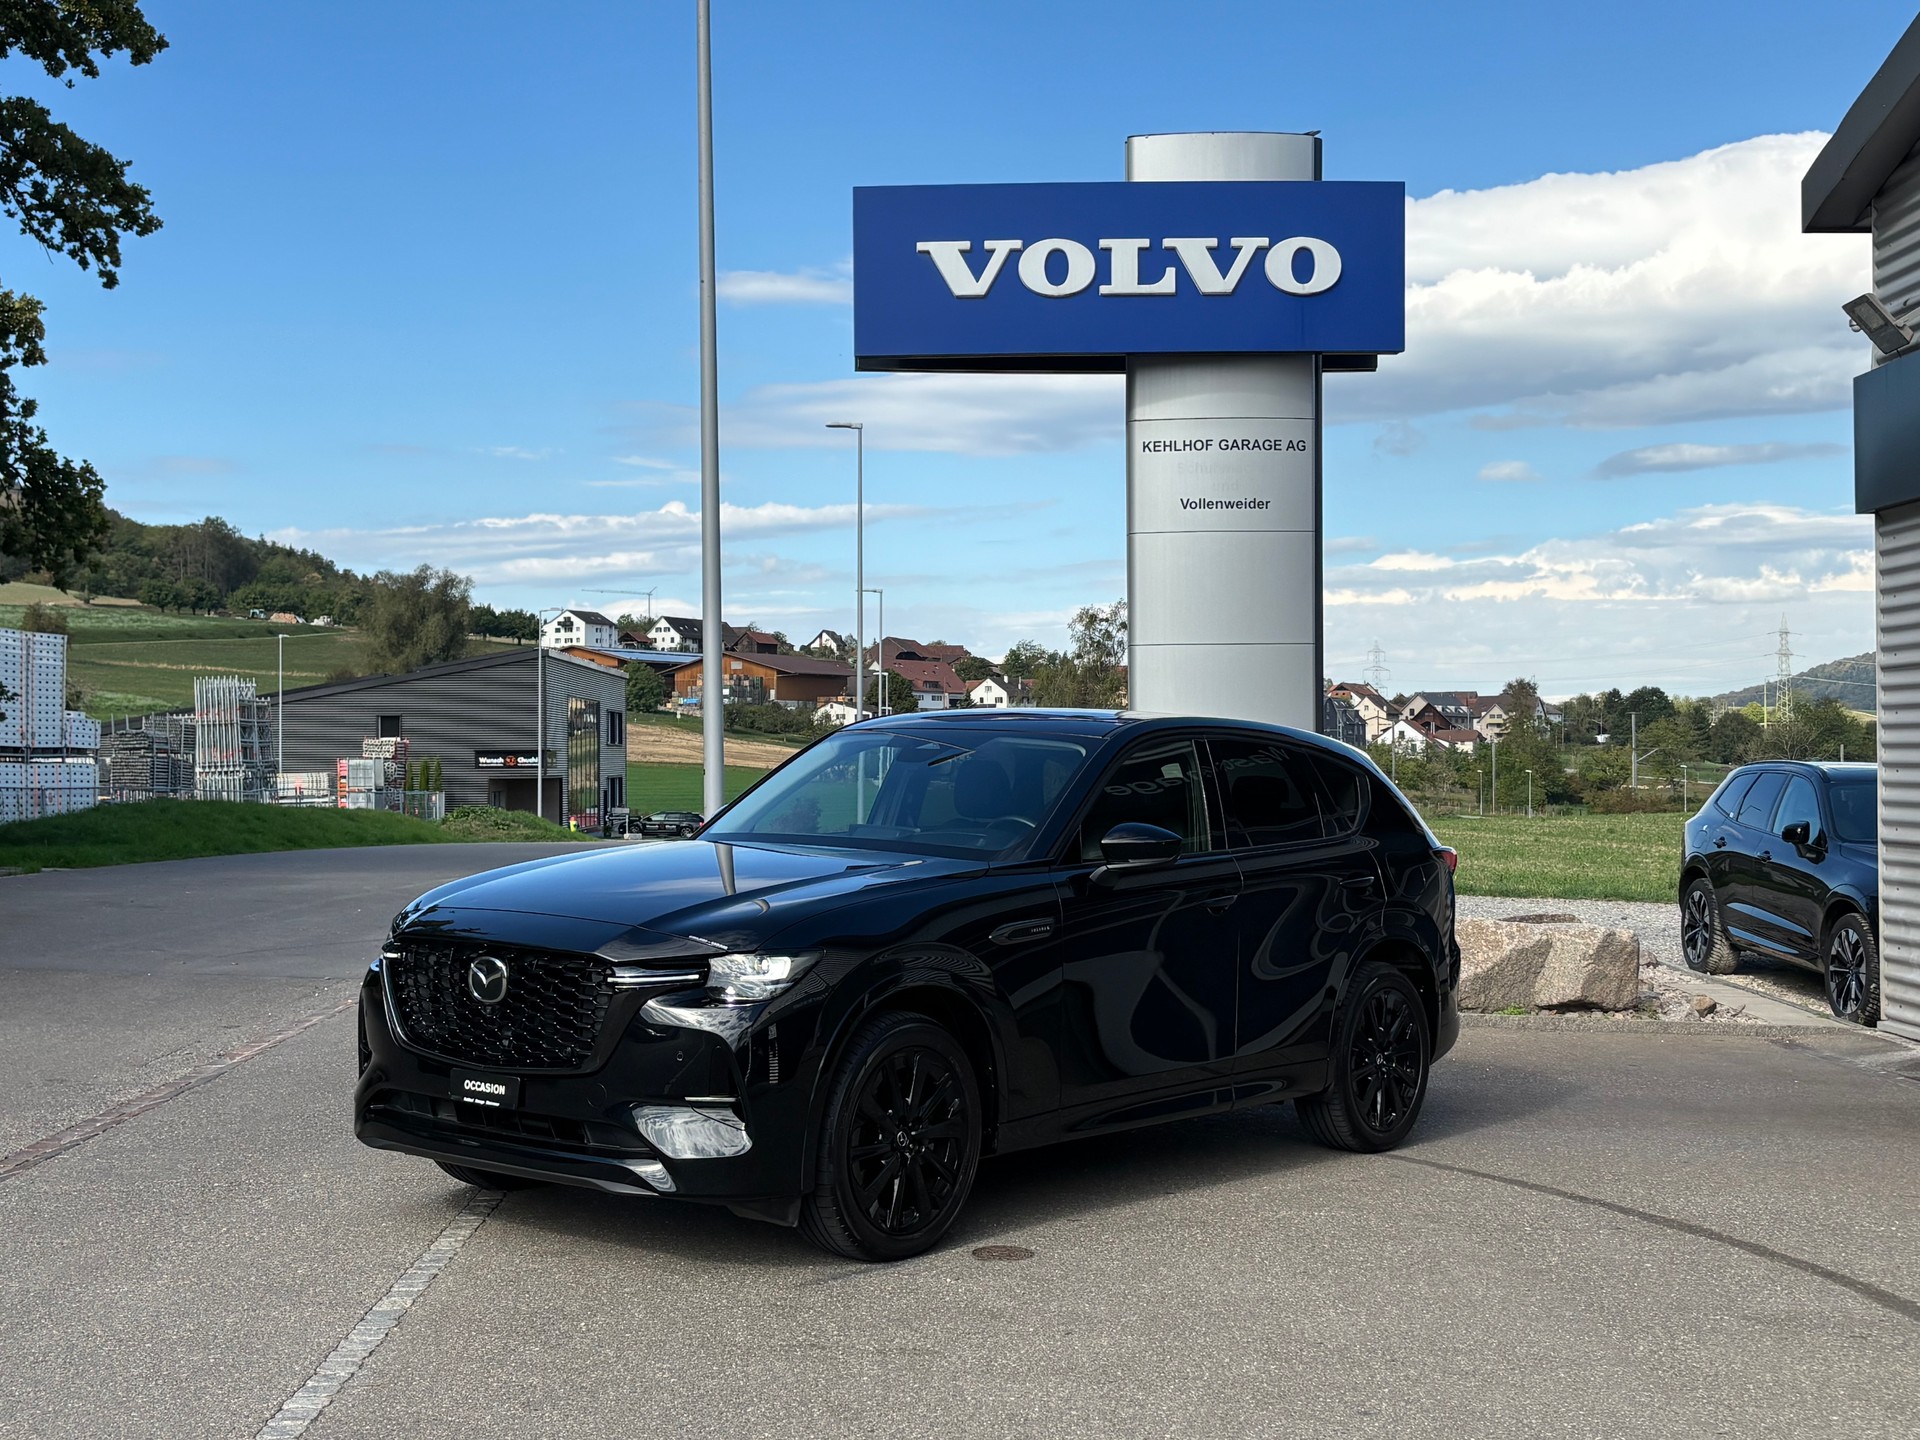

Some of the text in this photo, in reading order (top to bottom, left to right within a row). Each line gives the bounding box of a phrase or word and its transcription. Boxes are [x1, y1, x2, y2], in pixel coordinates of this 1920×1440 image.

[916, 236, 1342, 299] VOLVO
[1142, 439, 1307, 453] KEHLHOF GARAGE AG
[1180, 498, 1271, 510] Vollenweider
[464, 1079, 506, 1095] OCCASION
